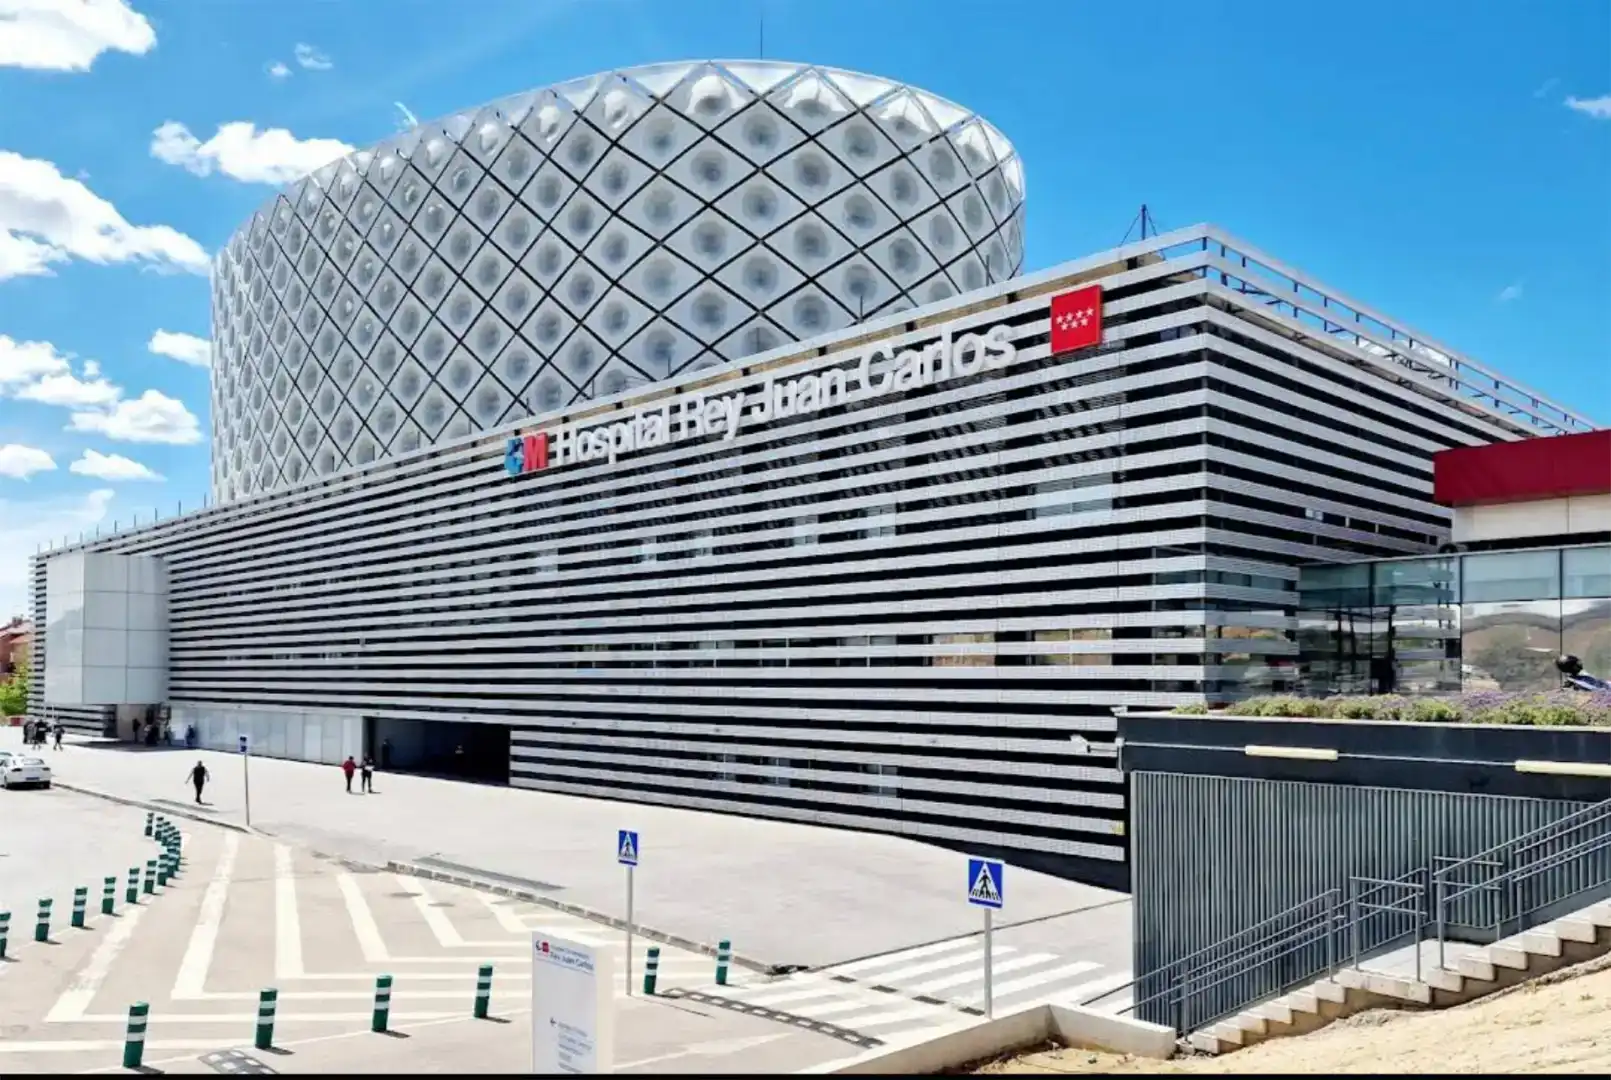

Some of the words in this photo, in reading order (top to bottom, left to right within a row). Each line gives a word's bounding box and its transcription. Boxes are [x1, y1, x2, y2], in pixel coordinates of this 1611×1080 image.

[555, 405, 671, 465] Hospital
[677, 390, 746, 442] Rey
[751, 375, 851, 424] Juan
[857, 324, 1017, 394] Carlos
